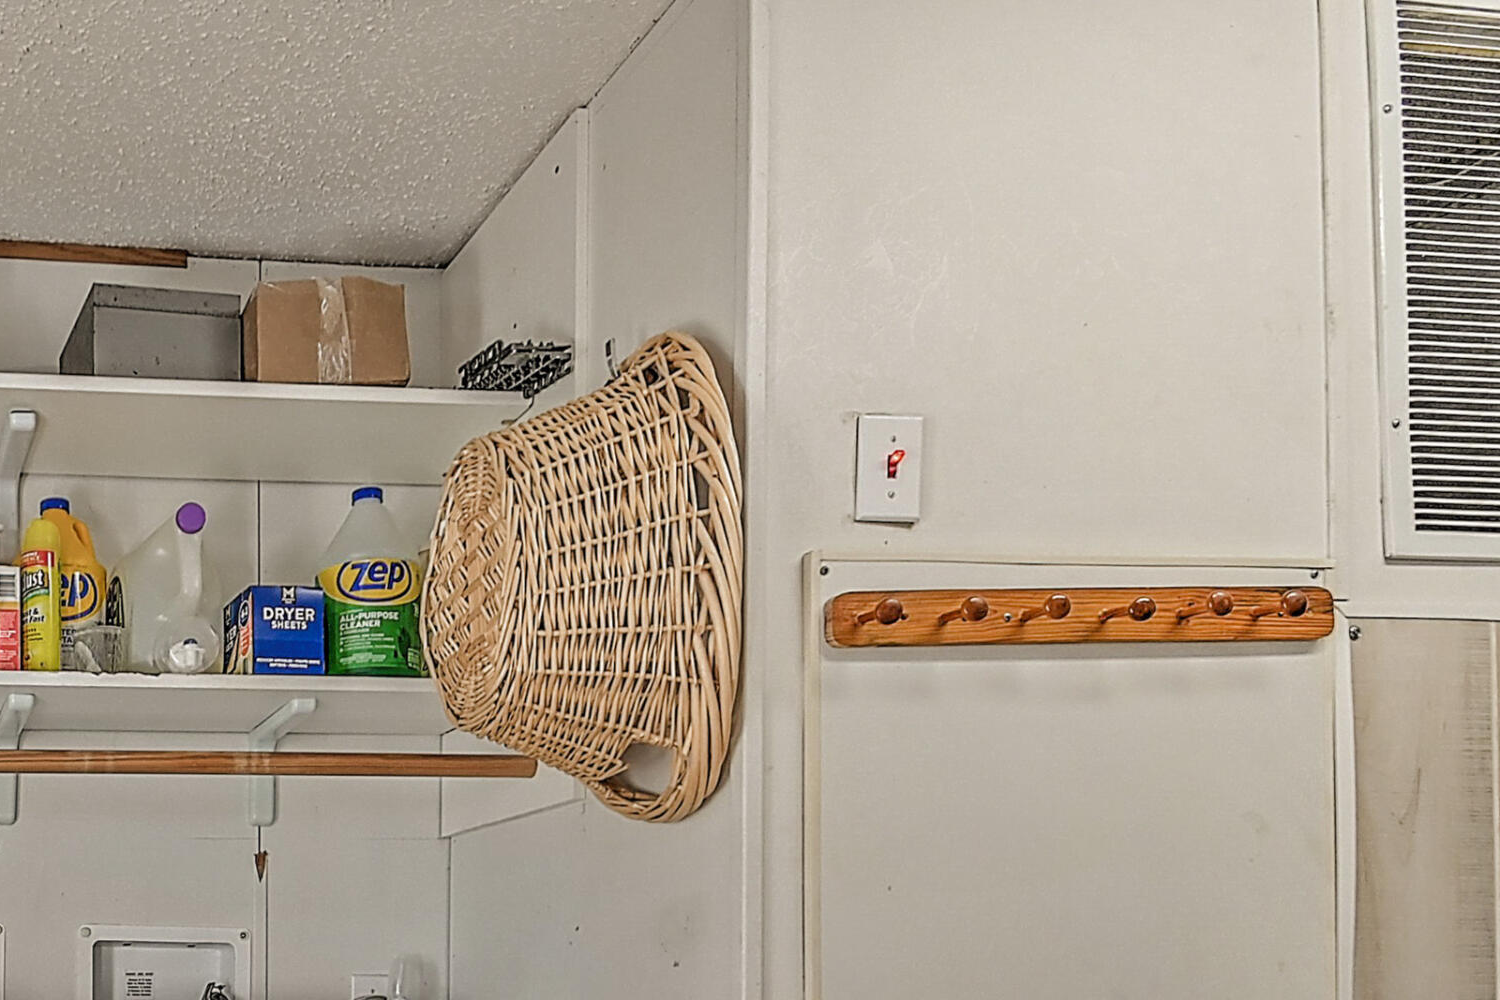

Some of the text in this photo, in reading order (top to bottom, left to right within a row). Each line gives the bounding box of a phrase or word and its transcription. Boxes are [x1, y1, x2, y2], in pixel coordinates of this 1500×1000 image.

[349, 560, 405, 592] Zep
[263, 607, 315, 621] DRYER
[340, 611, 399, 622] ALL-PURPOSE
[271, 620, 308, 630] SHEETS
[340, 620, 380, 630] CLEANER
